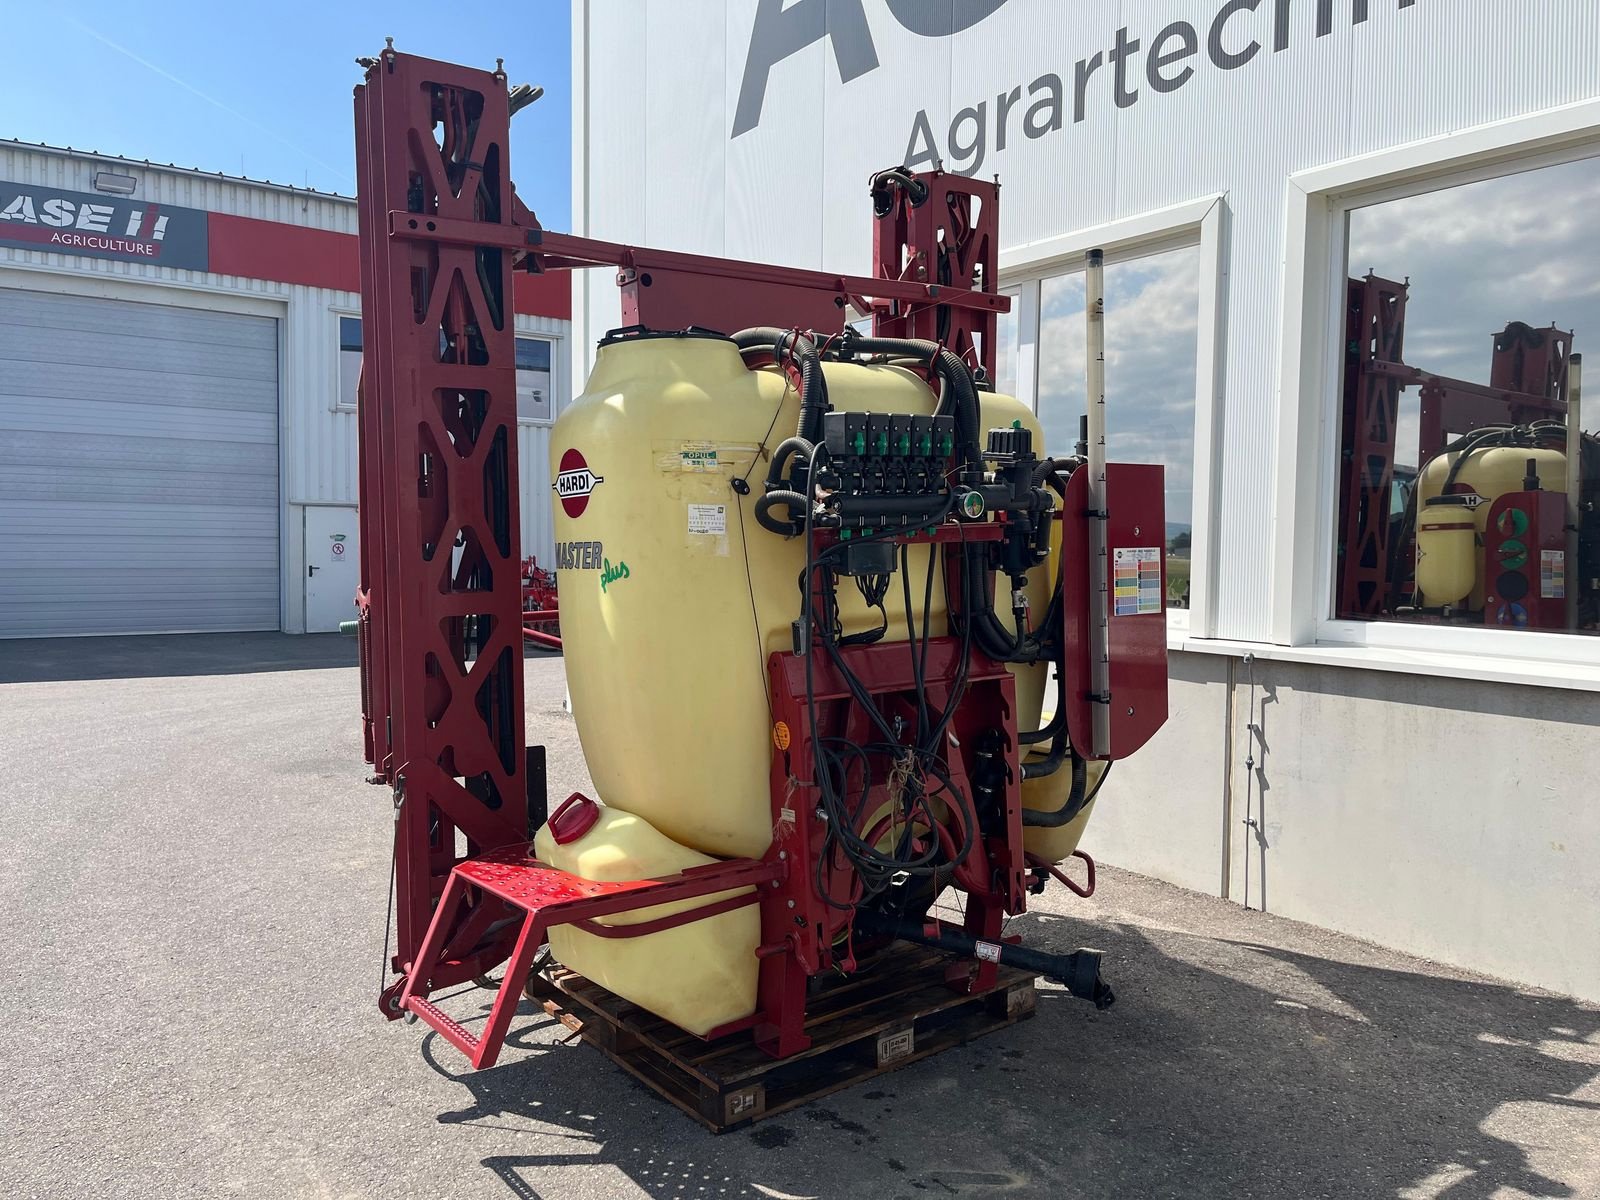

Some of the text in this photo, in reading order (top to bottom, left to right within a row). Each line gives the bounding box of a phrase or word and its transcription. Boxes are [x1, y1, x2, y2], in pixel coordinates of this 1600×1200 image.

[51, 232, 153, 255] AGRICULTURE
[559, 474, 589, 493] HARDI
[600, 557, 630, 593] plus
